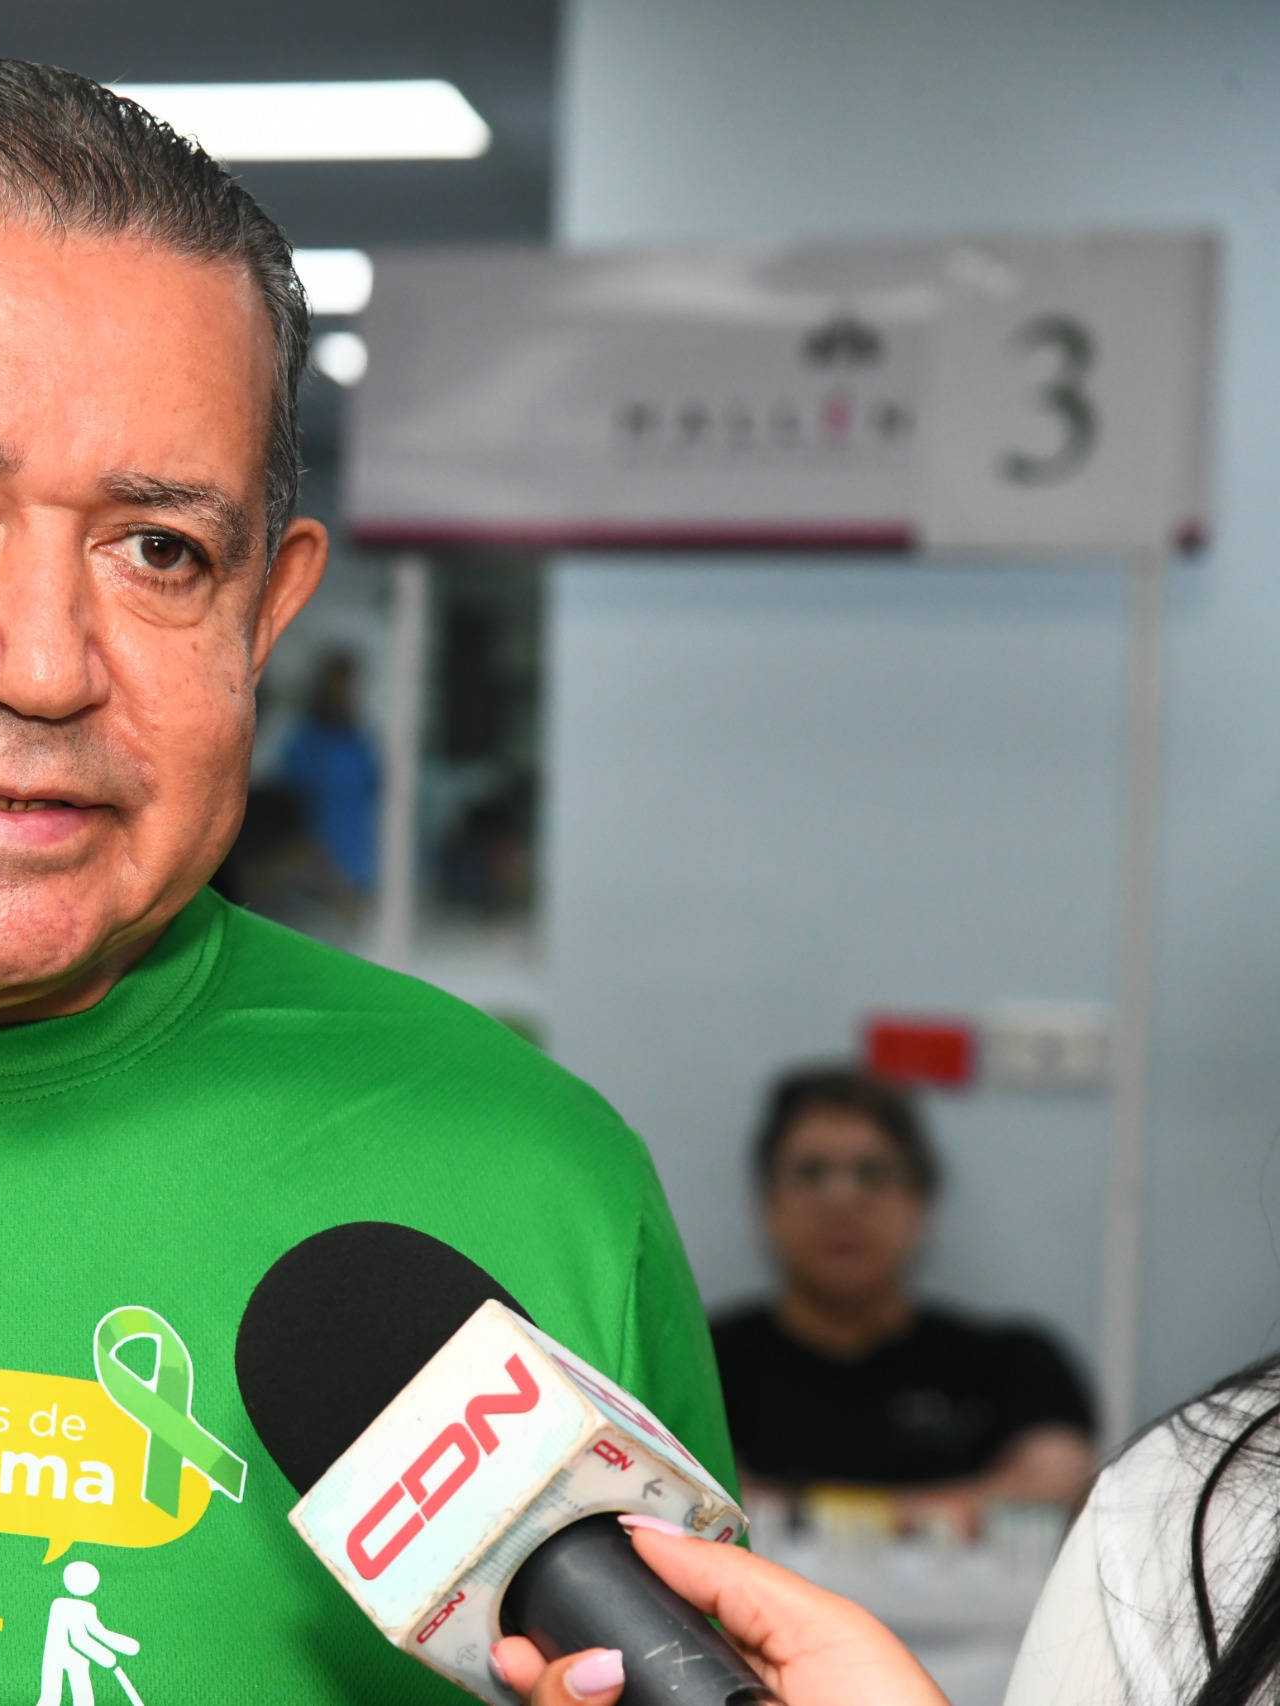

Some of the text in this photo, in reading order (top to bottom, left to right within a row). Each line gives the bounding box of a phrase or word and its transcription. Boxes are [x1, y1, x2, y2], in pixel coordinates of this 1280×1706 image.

[1000, 312, 1100, 488] 3
[29, 1402, 87, 1441] de
[346, 1354, 540, 1580] CDN
[417, 1592, 465, 1644] CDN
